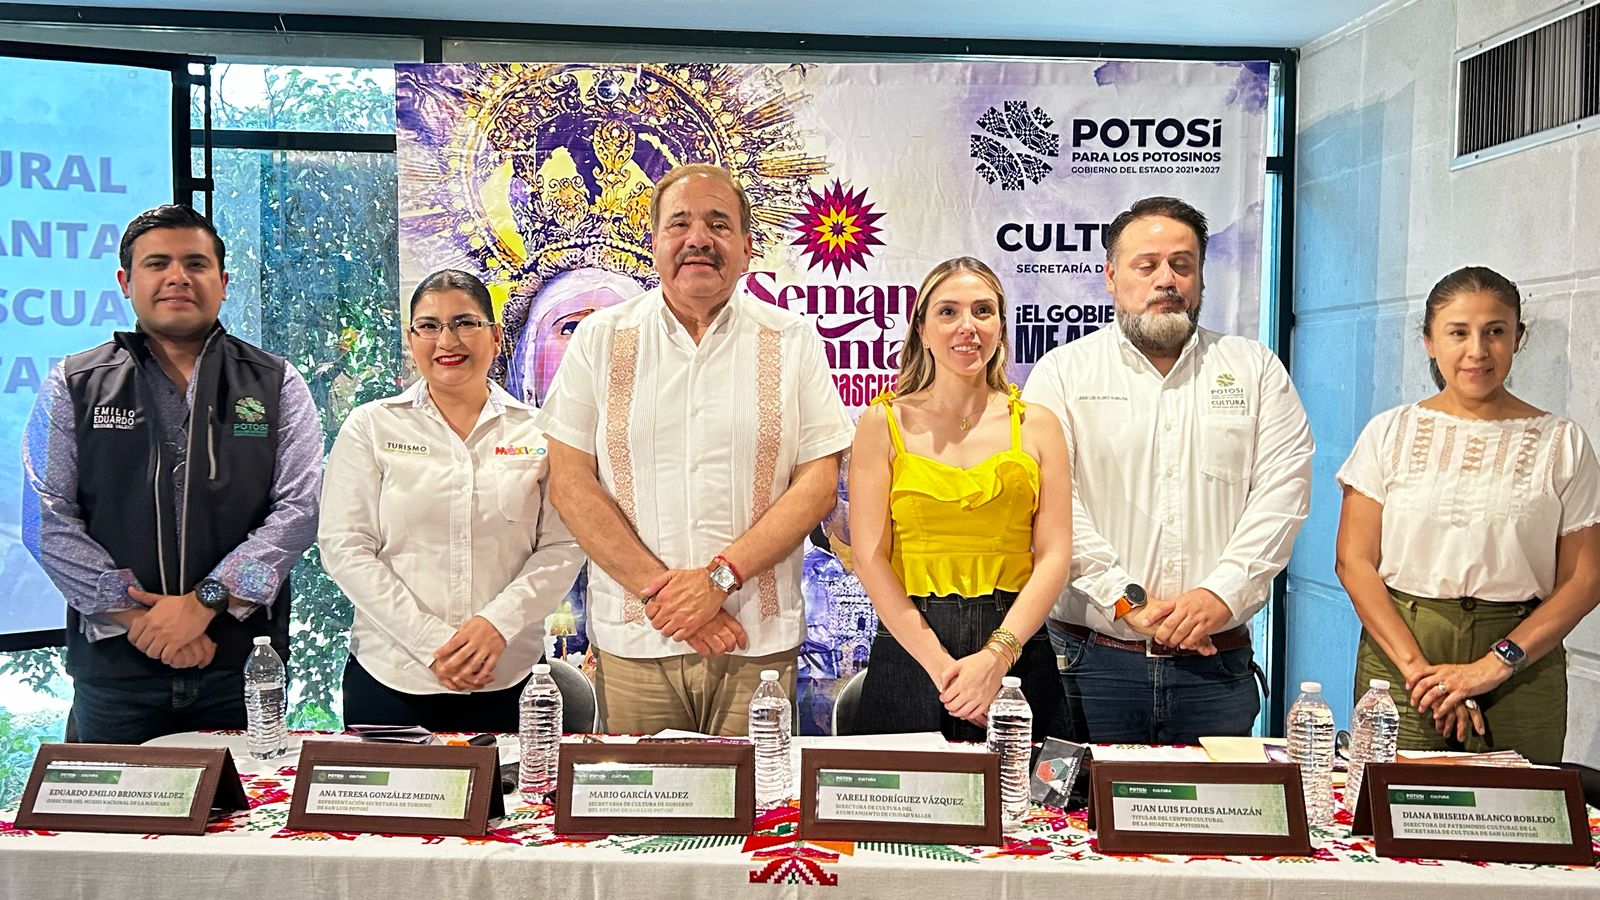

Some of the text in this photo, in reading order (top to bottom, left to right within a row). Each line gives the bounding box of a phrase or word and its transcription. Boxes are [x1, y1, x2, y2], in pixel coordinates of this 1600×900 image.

[1072, 152, 1221, 162] PARA LOS POTOSINOS
[1071, 166, 1117, 174] GOBIERNO
[1120, 166, 1137, 174] DEL
[1139, 166, 1173, 174] ESTADO
[0, 220, 121, 259] NTA
[1016, 262, 1104, 274] SECRETARÍA D
[740, 271, 917, 338] Seman
[1047, 304, 1115, 323] GOBIE
[94, 407, 135, 417] EMILIO
[94, 416, 134, 425] EDUARDO
[387, 442, 427, 452] TURISMO
[154, 791, 184, 799] VALDEZ
[369, 790, 411, 799] GONZÁLEZ
[620, 789, 653, 798] GARCÍA
[836, 793, 964, 806] YARELI RODRÍGUEZ VÁZQUEZ
[1131, 804, 1156, 812] JUAN
[1180, 806, 1214, 814] FLORES
[1216, 807, 1262, 816] ALMAZÁN
[1402, 812, 1556, 824] DIANA BRISEIDA BLANCO ROBLEDO
